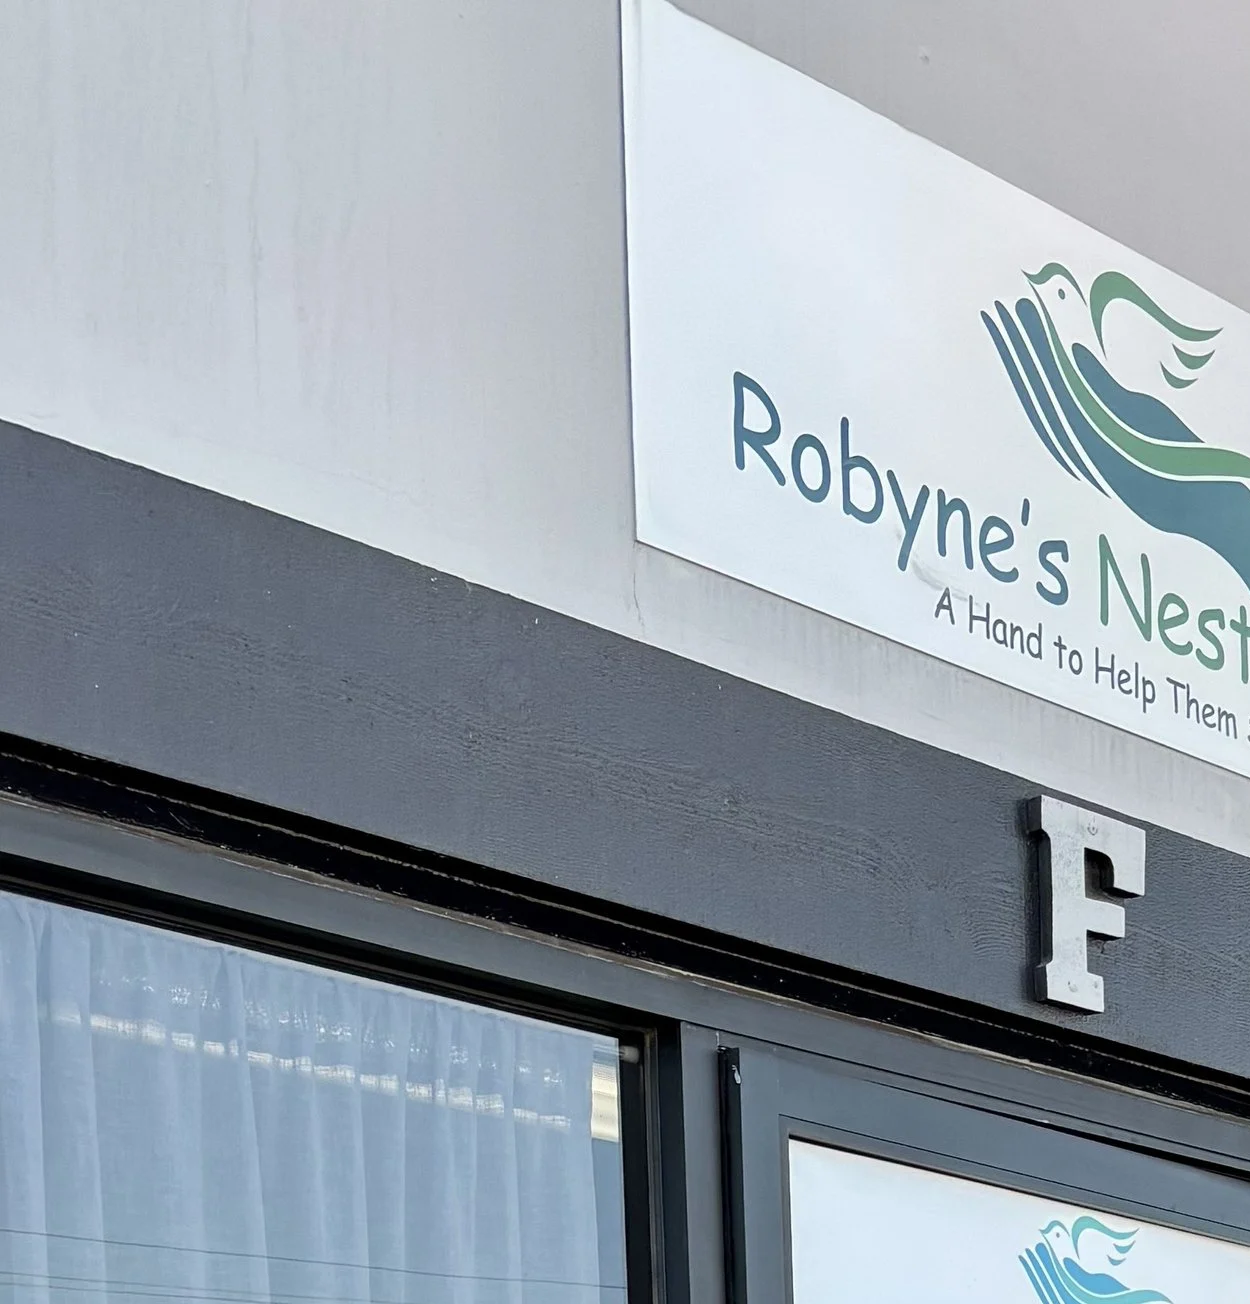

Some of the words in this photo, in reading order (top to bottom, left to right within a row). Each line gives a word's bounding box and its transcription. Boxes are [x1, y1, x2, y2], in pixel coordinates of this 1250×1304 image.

[733, 371, 1069, 606] Robyne's
[934, 587, 955, 623] A
[968, 600, 1043, 662] Hand
[1053, 633, 1084, 676] to
[1094, 654, 1156, 713] Help
[1165, 681, 1238, 740] Them
[1040, 795, 1146, 1013] F
